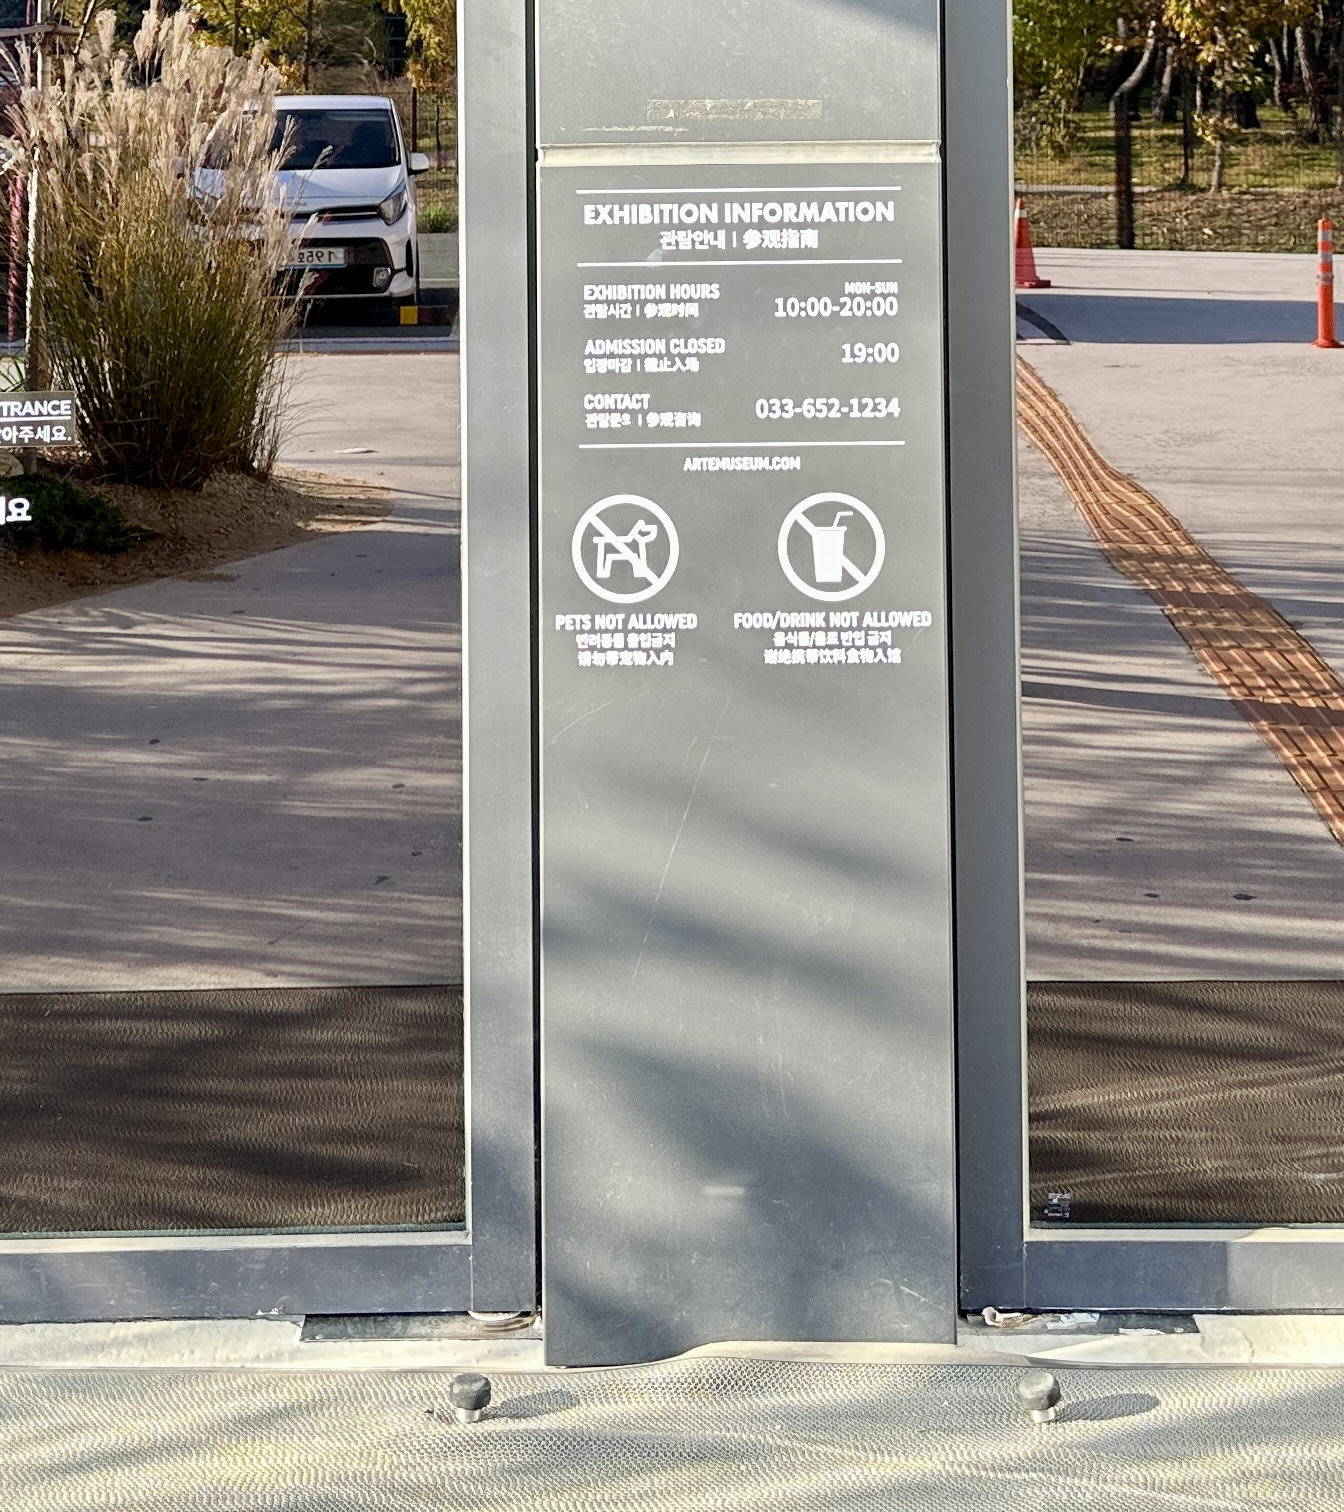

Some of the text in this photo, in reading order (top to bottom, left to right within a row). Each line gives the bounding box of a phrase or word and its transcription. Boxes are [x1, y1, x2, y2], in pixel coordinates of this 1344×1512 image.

[583, 200, 895, 225] EXHIBITION INFORMATION
[659, 228, 726, 251] 관람안내
[583, 283, 721, 301] EXHIBITION HOURS
[844, 281, 899, 295] MON-SUN
[583, 302, 633, 320] 관람시간
[774, 296, 899, 318] 10:00-20:00
[584, 337, 726, 356] ADMISSION CLOSED
[841, 342, 900, 364] 19:00
[583, 357, 633, 374] 입장마감
[583, 393, 651, 410] CONTACT
[755, 397, 901, 419] 033-652-1234
[683, 455, 801, 472] ARTEMUSEUM.COM
[555, 612, 698, 631] PETS NOT ALLOWED
[733, 610, 933, 630] FOOD/DRINK NOT ALLOWED
[840, 630, 866, 647] 반입
[866, 629, 892, 646] 금지
